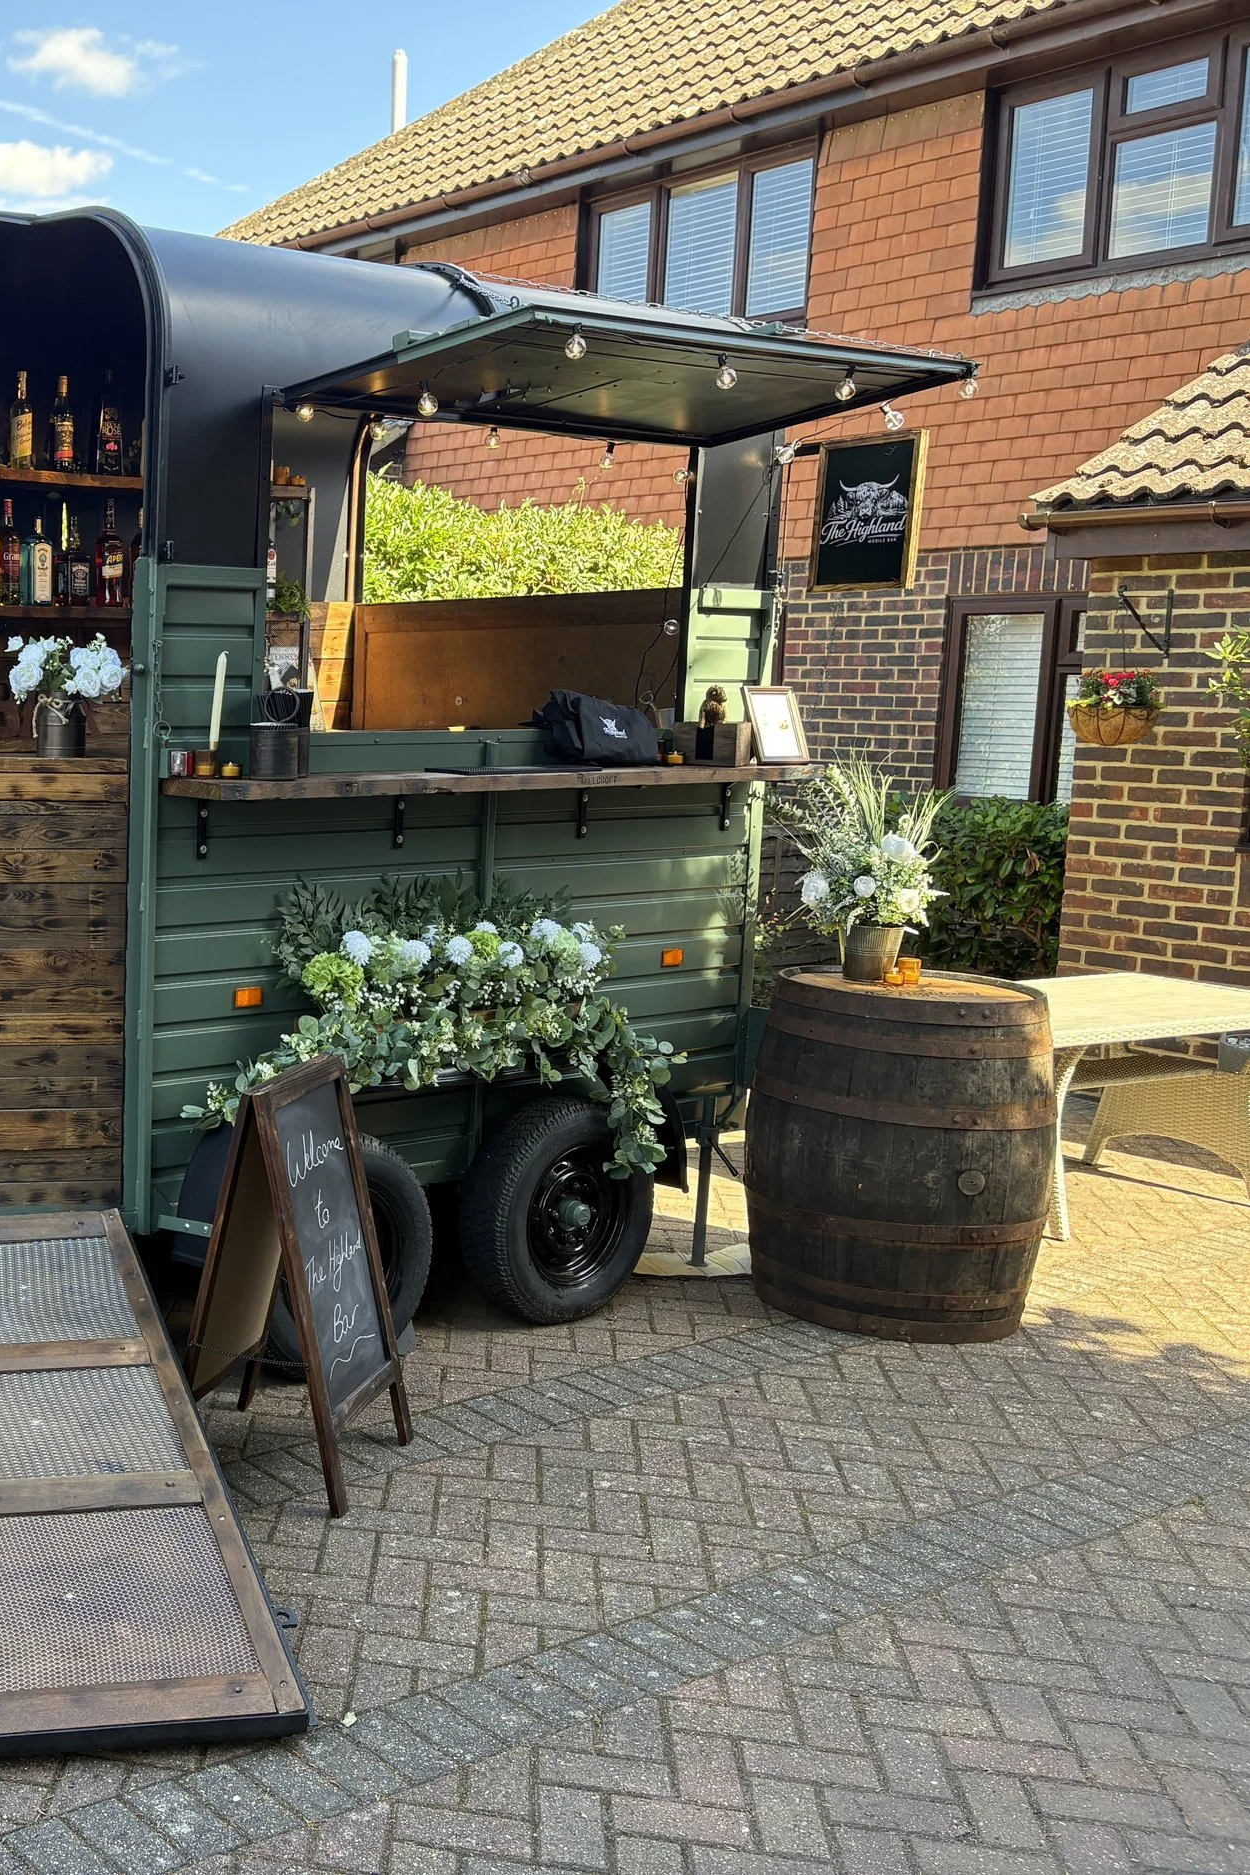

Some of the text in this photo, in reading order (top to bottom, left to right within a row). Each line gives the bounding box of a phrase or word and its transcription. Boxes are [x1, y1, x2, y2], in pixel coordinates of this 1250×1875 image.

[102, 426, 121, 436] ROSE
[820, 514, 908, 544] The Highland
[286, 1129, 345, 1188] Welcome
[314, 1189, 330, 1229] to
[305, 1228, 362, 1293] The Highland
[333, 1303, 360, 1343] Bar
